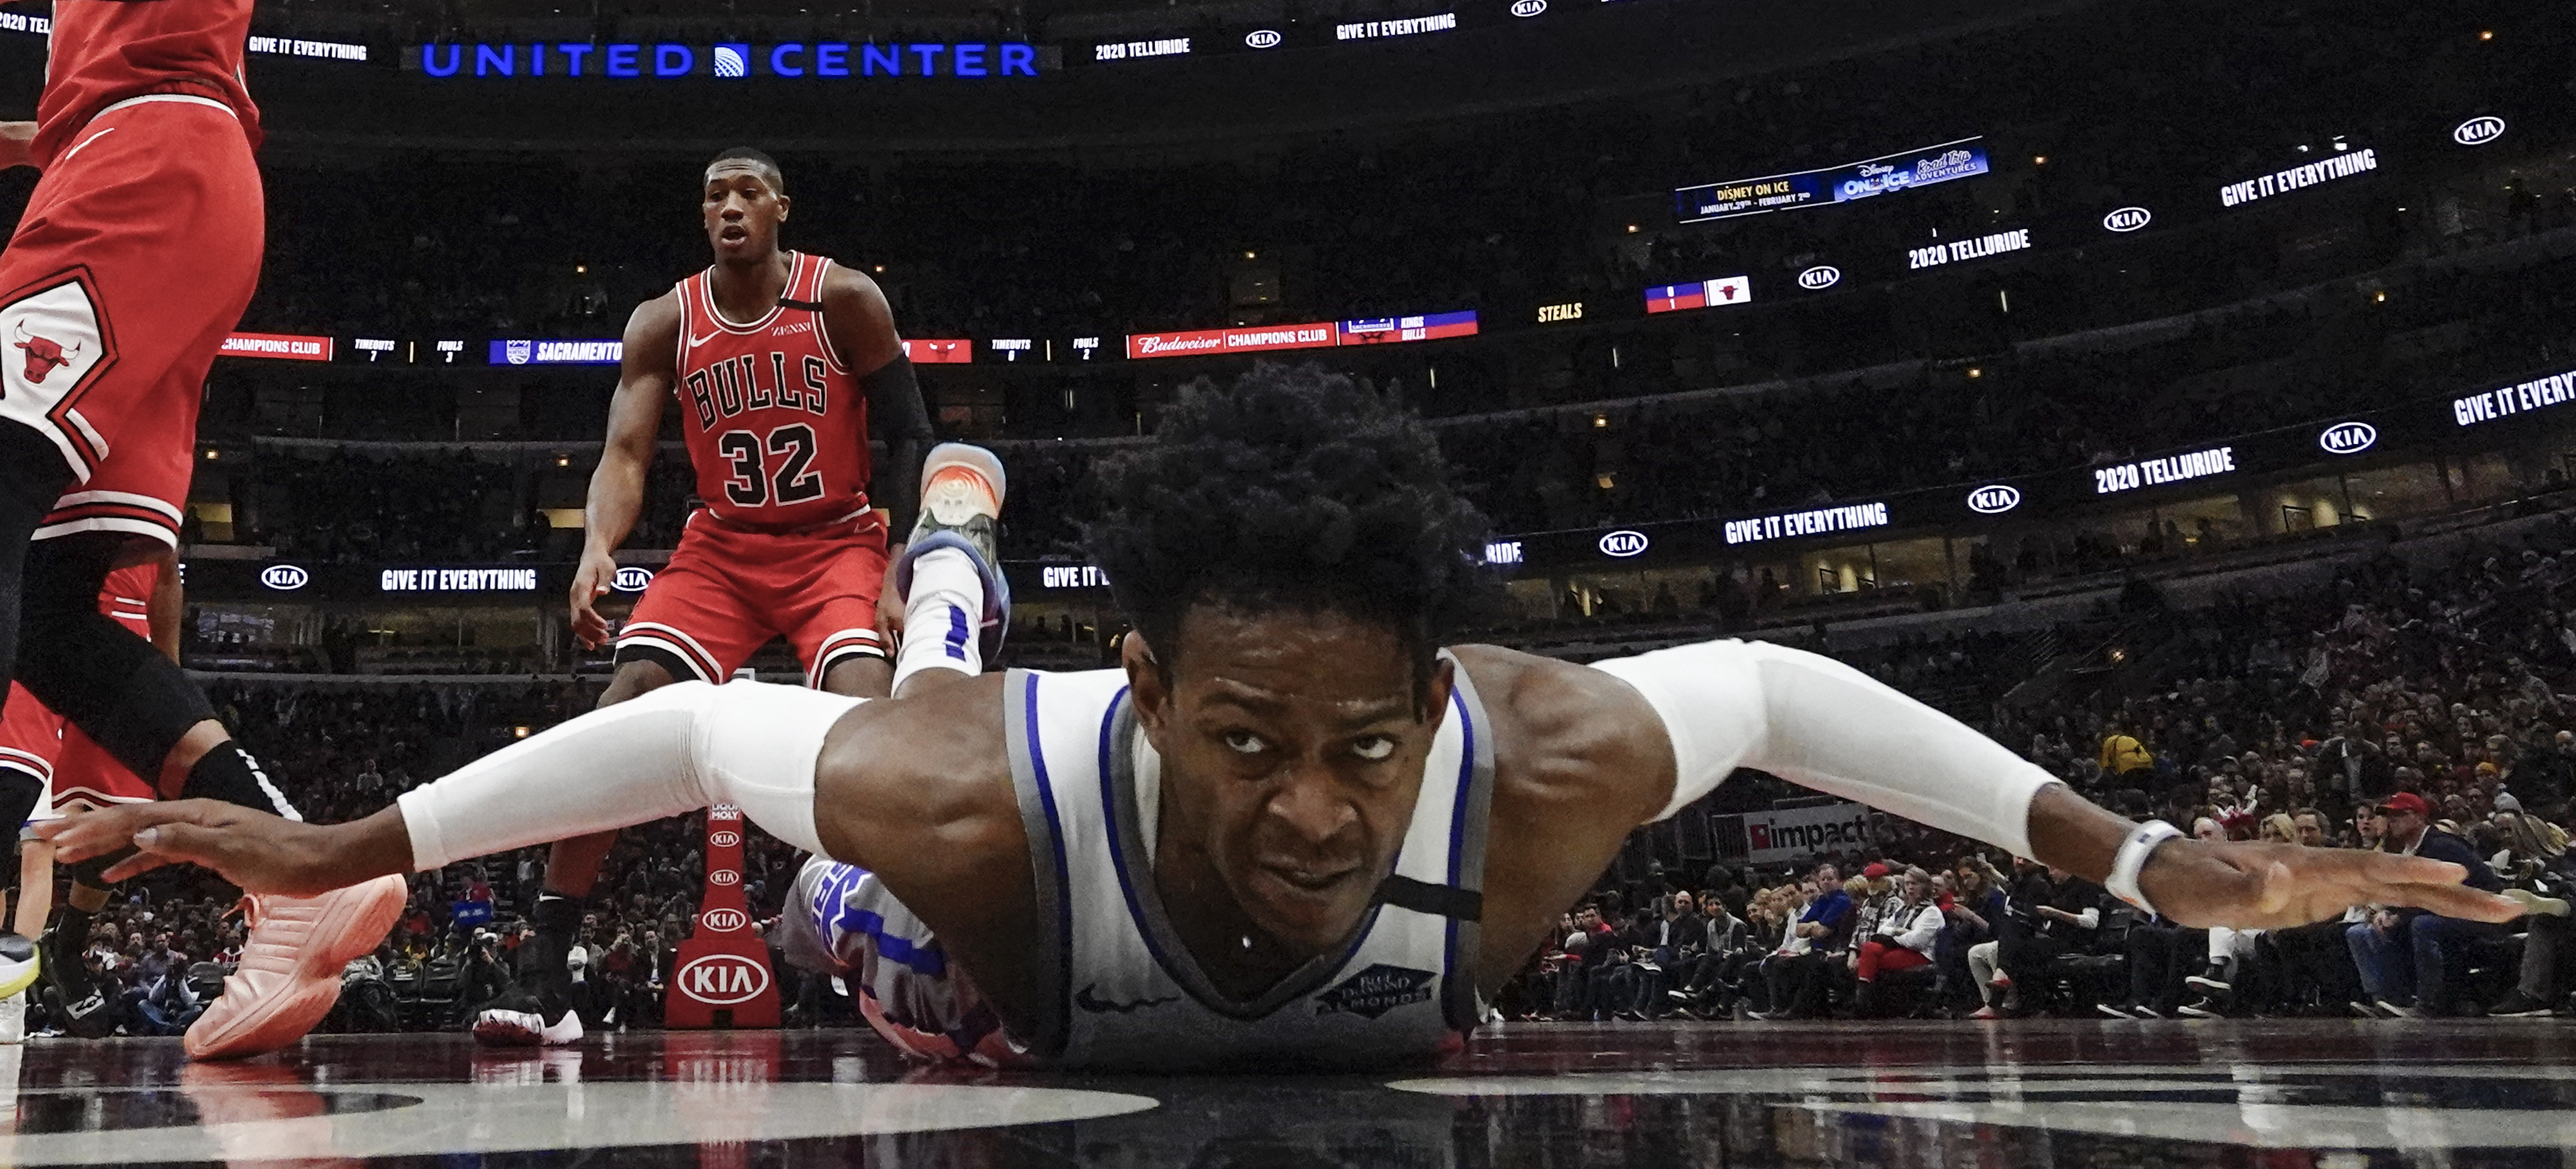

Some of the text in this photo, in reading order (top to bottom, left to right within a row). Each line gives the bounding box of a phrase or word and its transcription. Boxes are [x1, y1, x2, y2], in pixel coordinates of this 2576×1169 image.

[1517, 1, 1540, 14] KIA
[1337, 13, 1456, 39] GIVE IT EVERYTHING
[1251, 33, 1277, 45] KIA
[249, 37, 366, 60] GIVE IT EVERYTHING
[1096, 38, 1190, 60] 2020 TELLURIDE
[422, 42, 1038, 76] UNITED CENTER
[2462, 122, 2496, 141] KIA
[1915, 163, 1976, 181] ADVENTURES
[2221, 149, 2377, 206] GIVE IT EVERYTHING
[1717, 181, 1789, 201] DISNEY ON ICE
[1844, 171, 1910, 195] ON ICE
[1758, 193, 1795, 207] FEBRUARY
[2112, 213, 2143, 227] KIA
[1909, 229, 2030, 269] 2020 TELLURIDE
[1805, 271, 1833, 285] KIA
[1669, 299, 1675, 309] 1
[1539, 303, 1582, 322] STEALS
[1401, 316, 1424, 328] KINGS
[1138, 329, 1327, 353] Budweiser CHAMPIONS CLUB
[1402, 328, 1426, 340] BULLS
[291, 341, 320, 354] CLUB
[355, 339, 395, 351] TIMEOUTS
[437, 341, 463, 351] FOULS
[992, 340, 1031, 349] TIMEOUTS
[1074, 337, 1099, 349] FOULS
[371, 351, 377, 361] 7
[446, 352, 453, 362] 3
[537, 342, 623, 361] SACRAMENTO
[1083, 349, 1090, 360] 2
[685, 351, 827, 433] BULLS
[2454, 392, 2497, 425] GIVE
[2498, 387, 2515, 415] IT
[2329, 429, 2366, 448] KIA
[718, 422, 825, 508] 32
[2096, 447, 2235, 493] 2020 TELLURIDE
[1976, 492, 2013, 508] KIA
[1726, 502, 1887, 544] GIVE IT EVERYTHING
[1608, 537, 1641, 551] KIA
[269, 571, 300, 584] KIA
[382, 569, 536, 590] GIVE IT EVERYTHING
[616, 572, 647, 586] KIA
[1043, 567, 1079, 587] GIVE
[1082, 566, 1097, 586] IT
[712, 811, 739, 820] MOLY
[715, 835, 736, 844] KIA
[1770, 813, 1866, 851] impact
[715, 873, 736, 882] KIA
[710, 912, 739, 927] KIA
[694, 966, 754, 993] KIA
